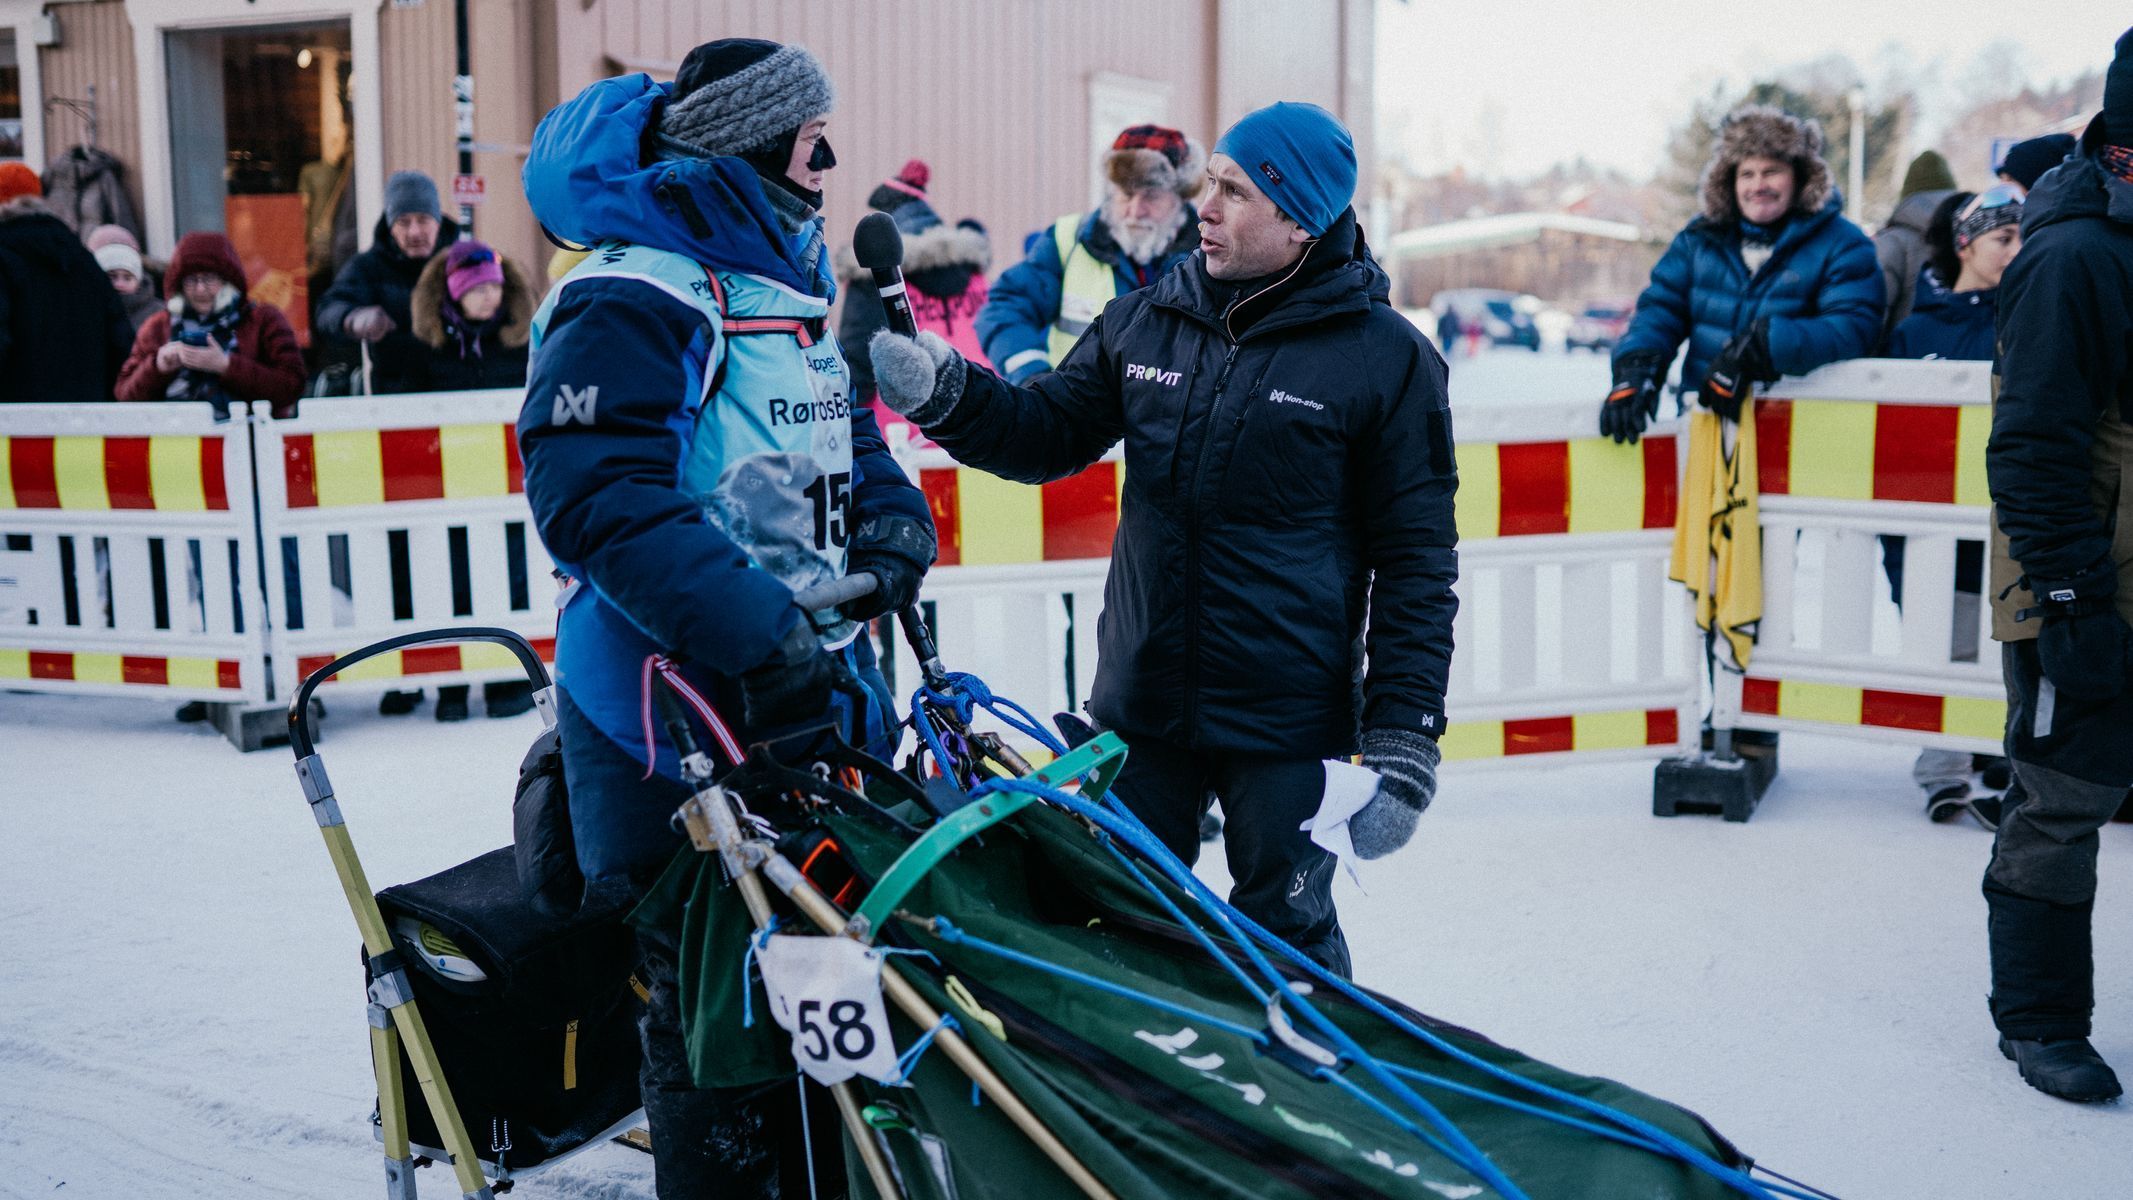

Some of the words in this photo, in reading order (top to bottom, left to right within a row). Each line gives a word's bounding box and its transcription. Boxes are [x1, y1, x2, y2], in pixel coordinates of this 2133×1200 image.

[1126, 363, 1182, 386] PROVIT
[1284, 394, 1325, 411] Non-stop
[803, 471, 851, 551] 15
[799, 1000, 876, 1062] 58
